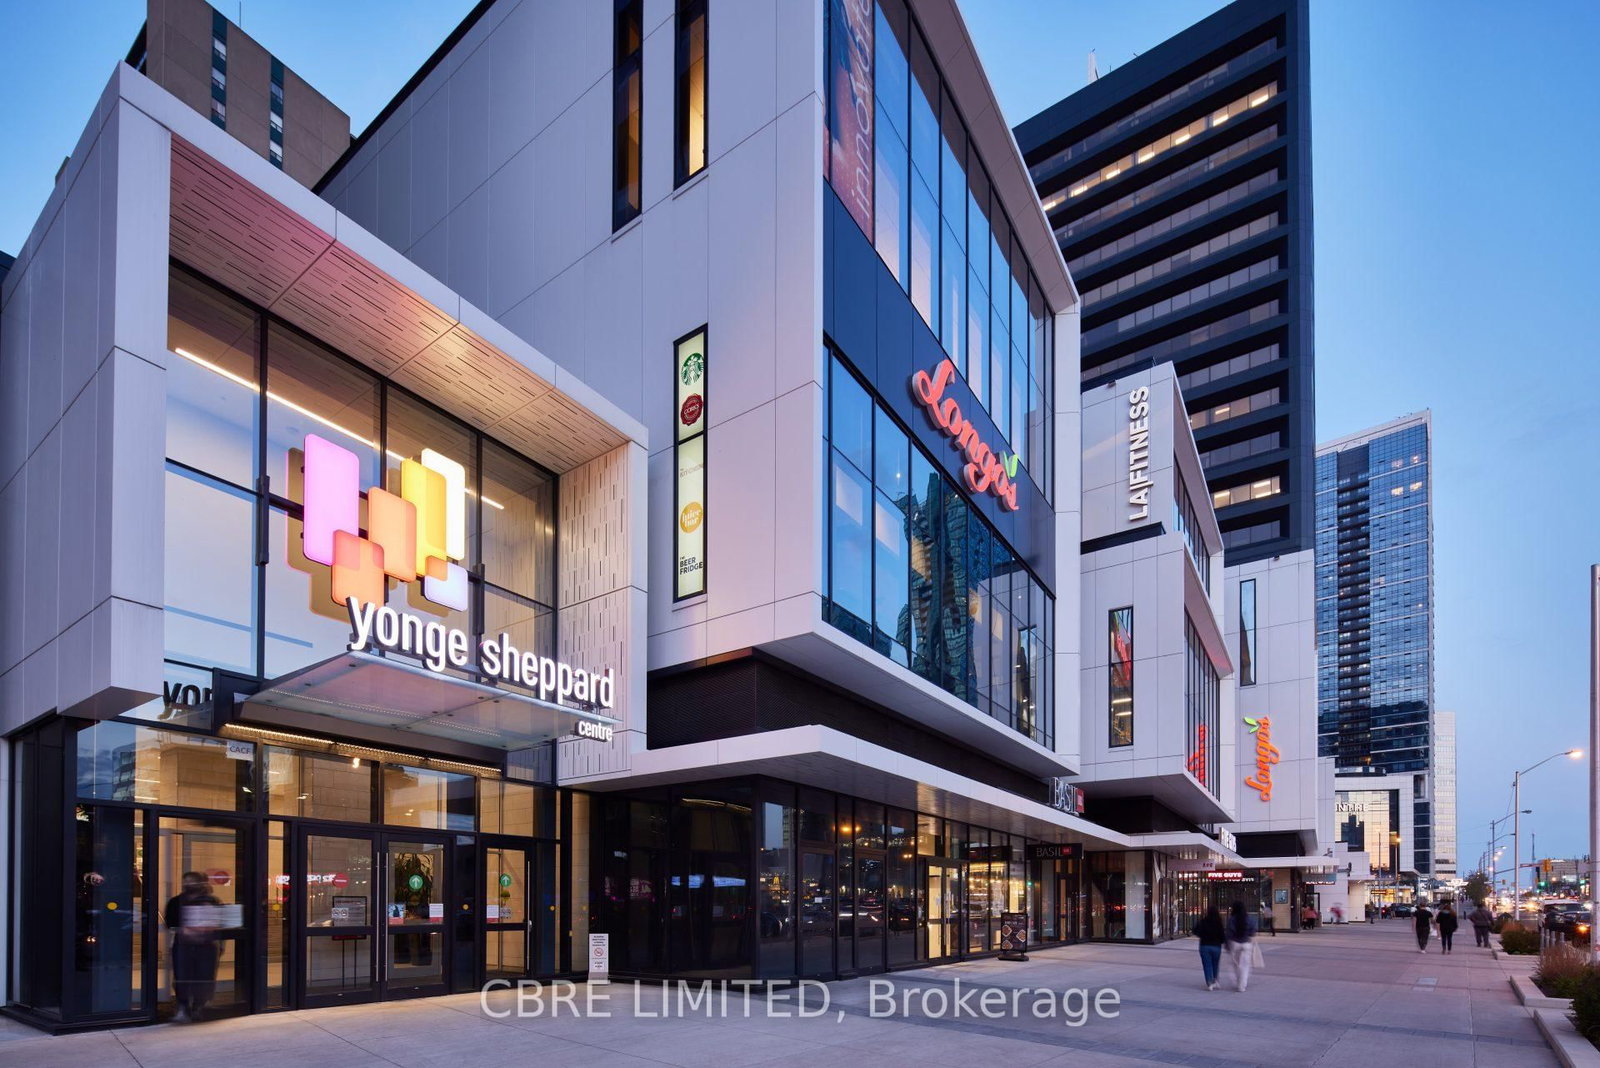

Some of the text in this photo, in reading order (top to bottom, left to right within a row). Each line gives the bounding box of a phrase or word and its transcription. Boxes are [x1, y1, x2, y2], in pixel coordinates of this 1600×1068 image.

[680, 556, 696, 567] BEER
[680, 561, 704, 575] FRIDGE
[346, 597, 615, 709] yonge sheppard
[577, 719, 613, 742] centre
[1052, 777, 1079, 816] BASIL
[1036, 847, 1063, 857] BASIL
